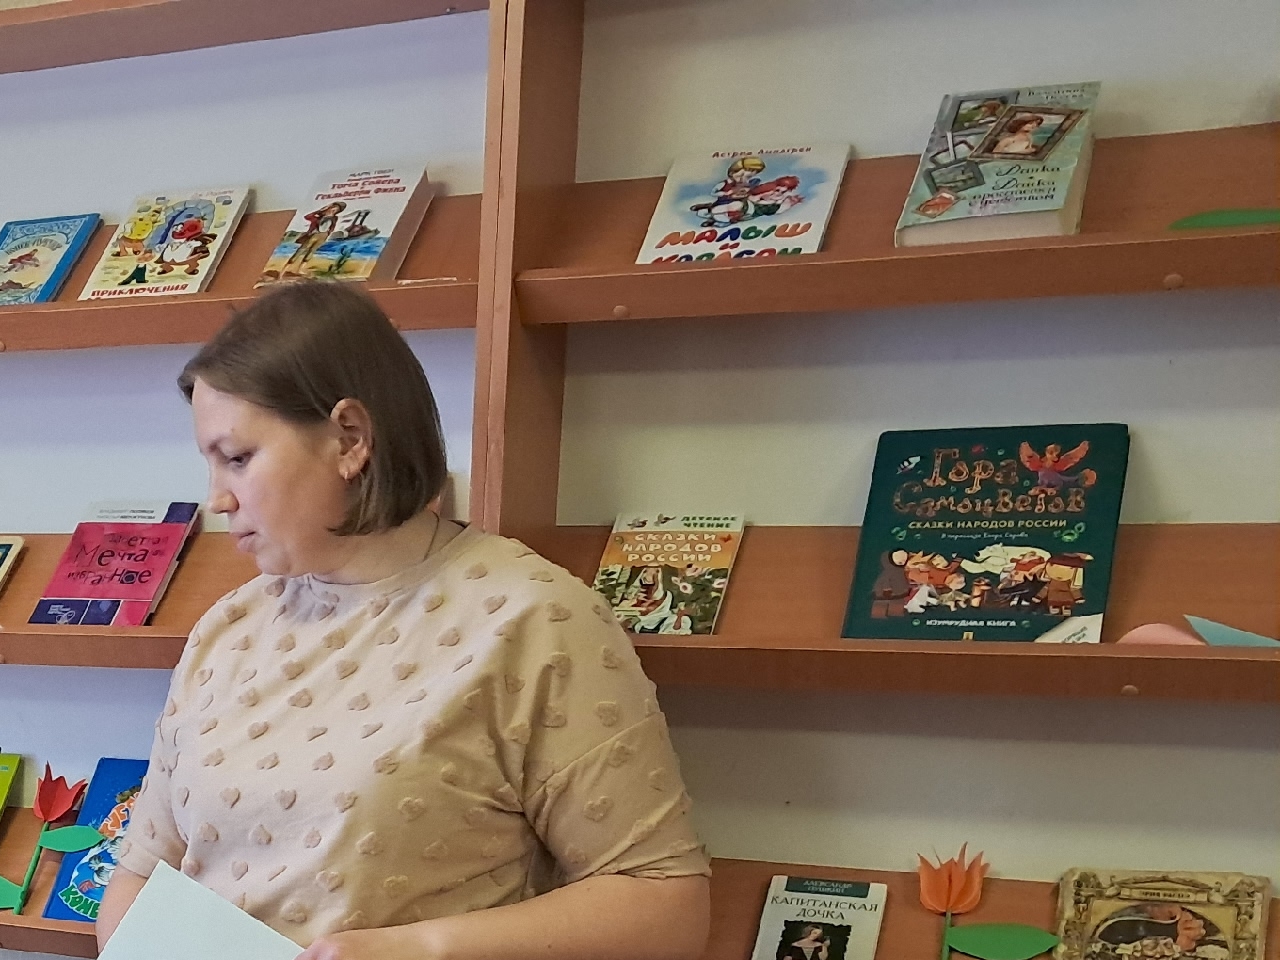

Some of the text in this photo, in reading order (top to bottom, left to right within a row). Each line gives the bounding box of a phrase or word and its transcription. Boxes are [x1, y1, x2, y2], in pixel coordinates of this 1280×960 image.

[655, 222, 813, 248] МАЛЫШ
[91, 283, 190, 297] ПРИКЛЮЧЕНИЯ
[923, 448, 1018, 494] Гора
[893, 481, 1086, 517] Самоцветов
[908, 519, 1066, 530] СКАЗКИ НАРОДОВ РОССИИ
[634, 533, 717, 541] СКАЗКИ
[622, 543, 722, 552] НАРОДОВ
[74, 544, 150, 567] Мечта
[627, 553, 712, 562] РОССИИ
[986, 619, 1016, 627] КНИГА
[771, 896, 878, 912] КАПИТАНСКАЯ
[796, 908, 846, 920] ДОЧКА
